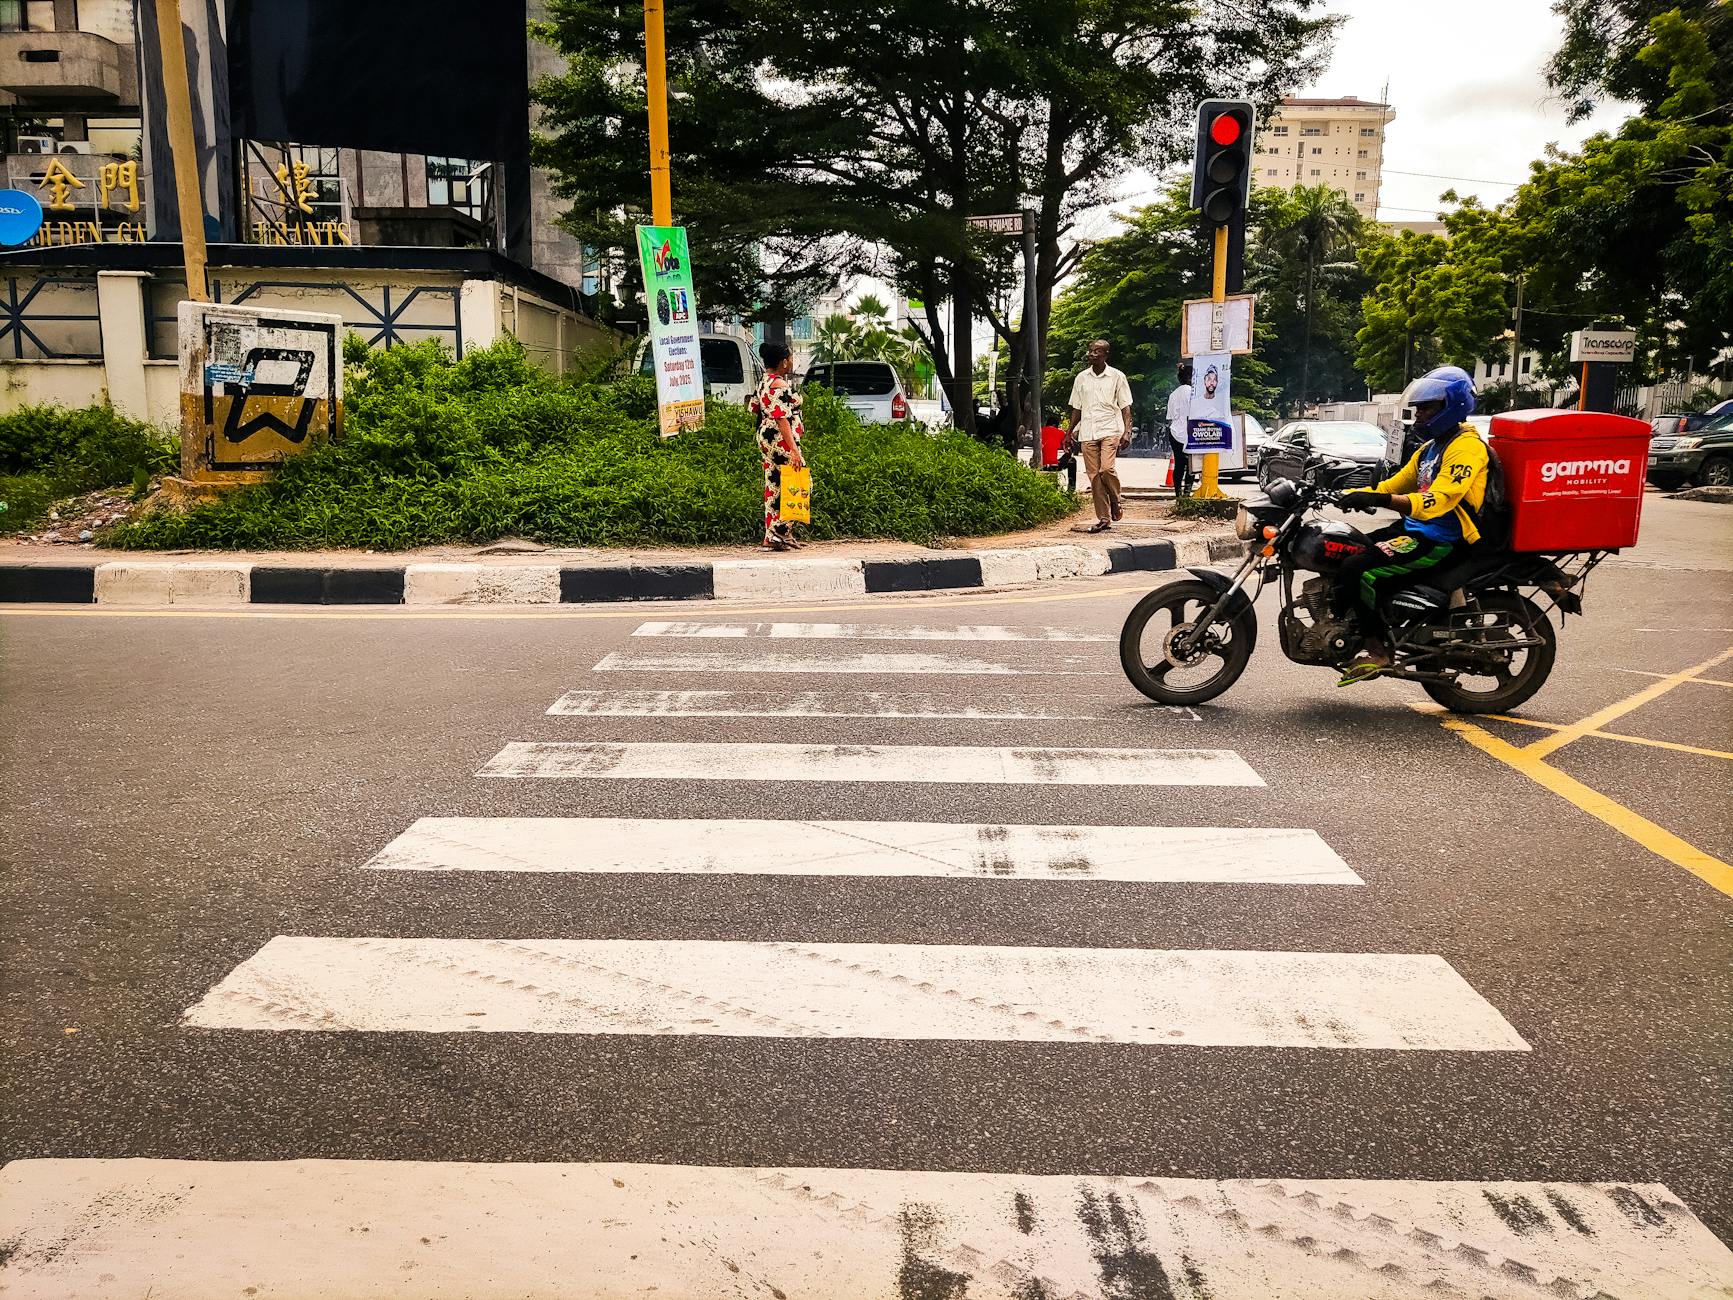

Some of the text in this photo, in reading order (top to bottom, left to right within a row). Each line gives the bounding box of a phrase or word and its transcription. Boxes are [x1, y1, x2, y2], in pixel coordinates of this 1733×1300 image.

[1014, 217, 1022, 230] RD
[29, 222, 103, 246] OLDEN
[670, 335, 693, 345] Government
[1583, 337, 1633, 350] Transcorp
[664, 360, 684, 372] Saturday
[1449, 464, 1472, 477] 126
[1541, 459, 1631, 482] gamma
